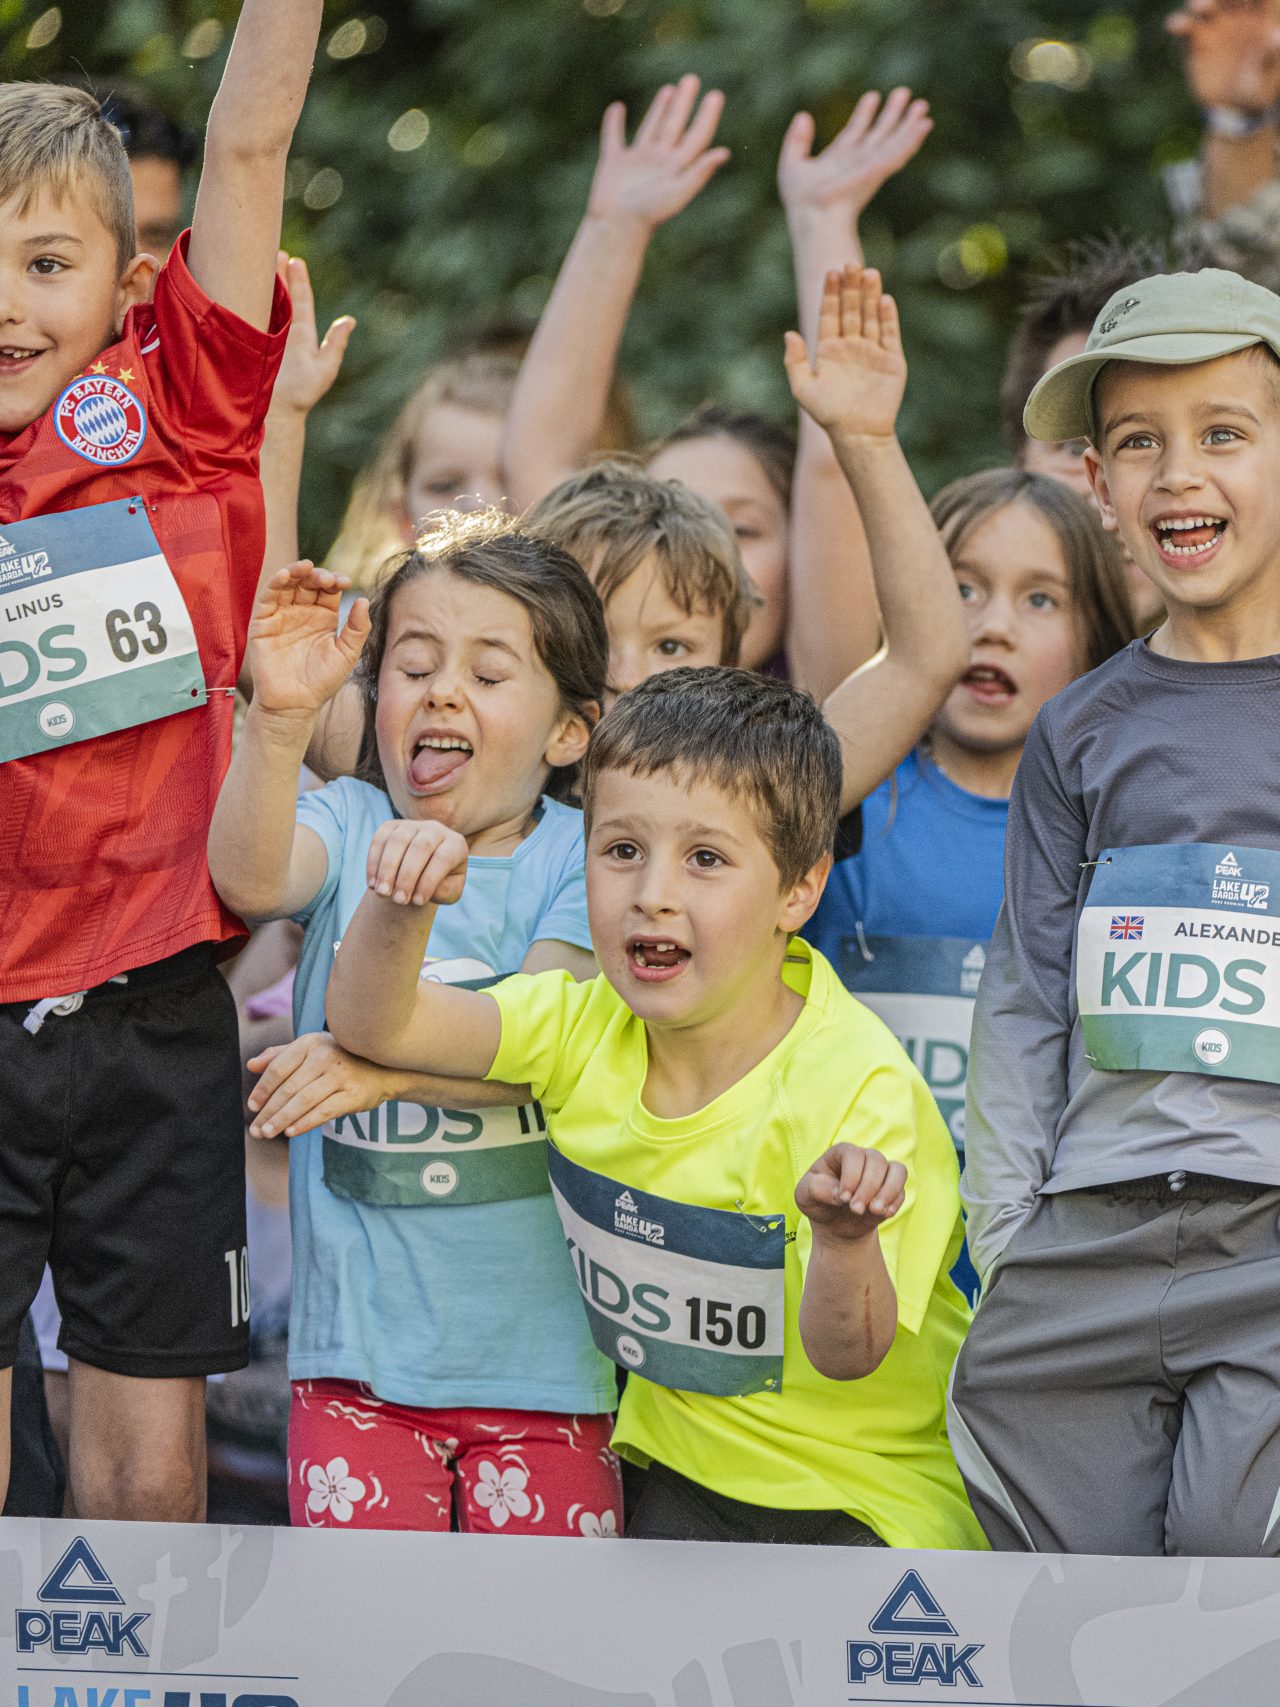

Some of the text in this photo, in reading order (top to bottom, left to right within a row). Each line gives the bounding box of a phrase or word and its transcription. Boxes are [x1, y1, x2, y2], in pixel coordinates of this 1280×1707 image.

[60, 381, 134, 417] FC BAYERN
[72, 429, 140, 460] MÜNCHEN
[0, 543, 17, 557] EAK
[0, 558, 22, 573] AKE
[5, 594, 63, 622] LINUS
[0, 601, 168, 698] DS 63
[46, 713, 67, 728] KIDS
[1215, 864, 1243, 877] PEAK
[1212, 890, 1240, 901] GARDA
[1213, 879, 1241, 892] LAKE
[1100, 951, 1267, 1015] KIDS
[1201, 1041, 1222, 1053] KIDS
[430, 1174, 450, 1184] KIDS
[614, 1211, 639, 1227] LAKE
[224, 1246, 250, 1328] 10
[567, 1237, 766, 1349] IDS 150
[15, 1609, 151, 1657] PEAK
[847, 1640, 986, 1687] PEAK
